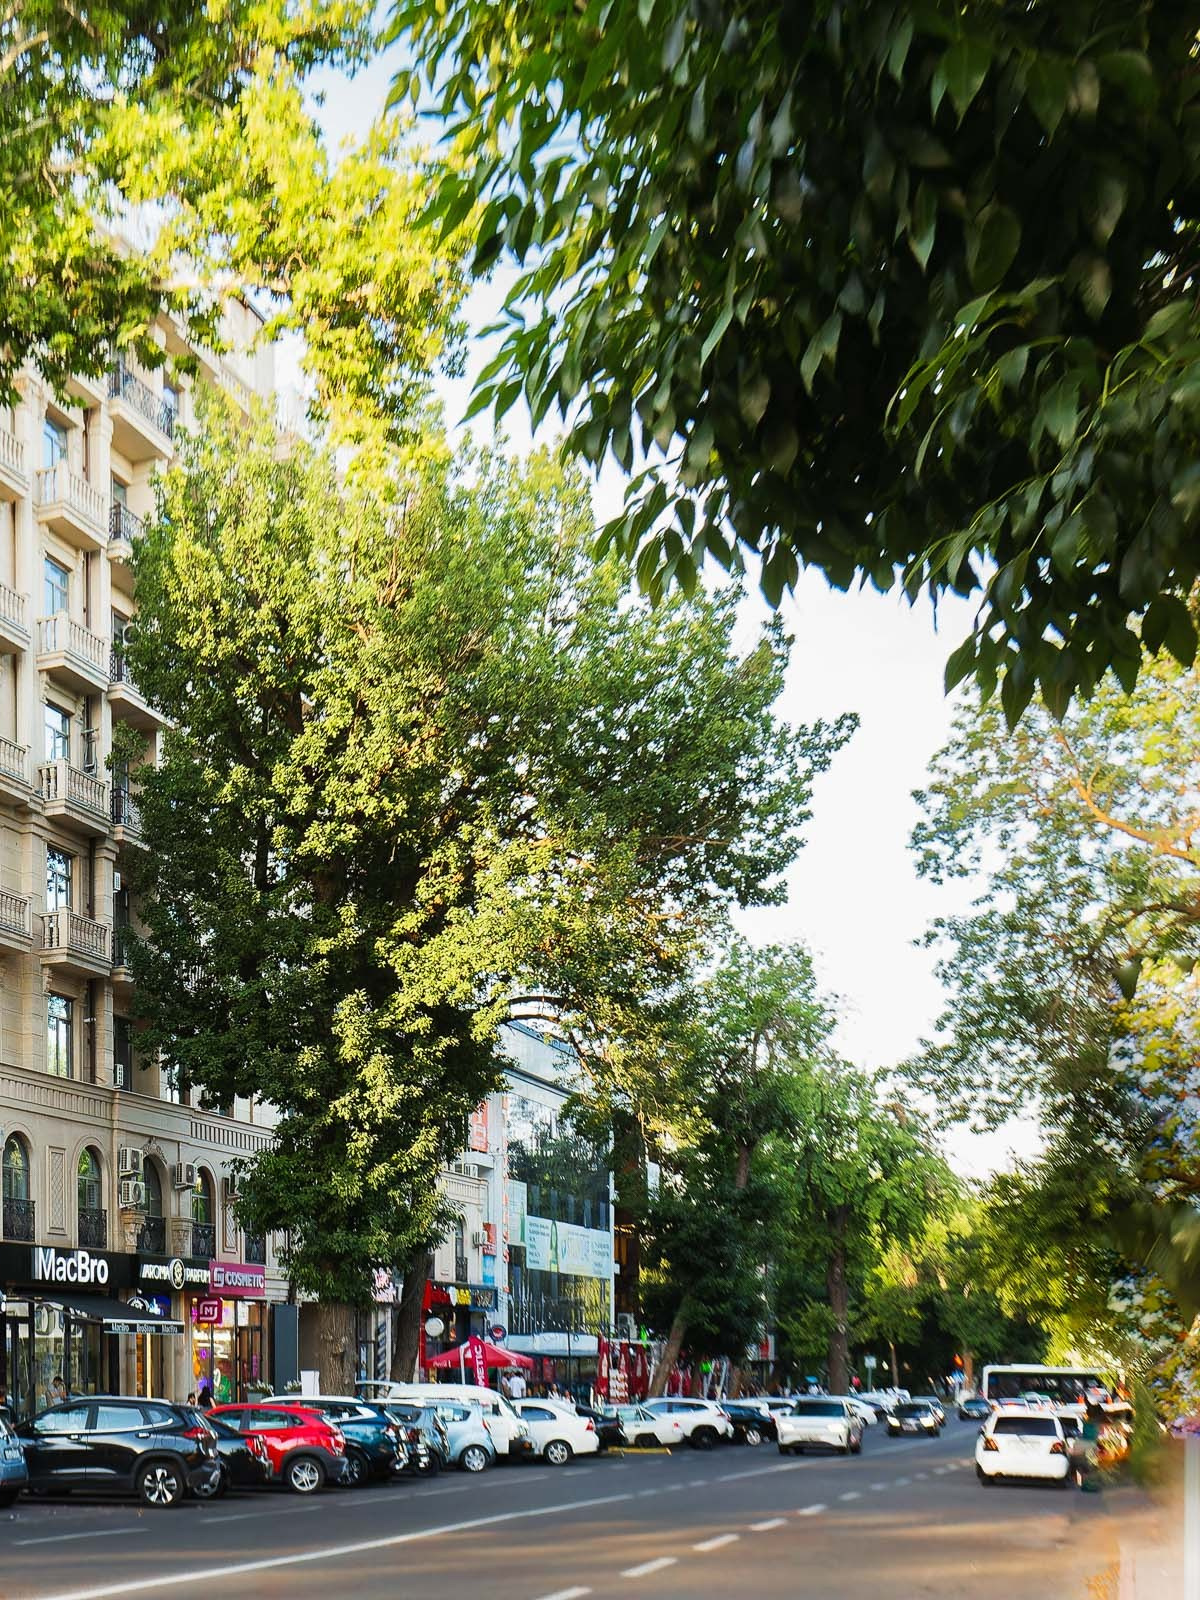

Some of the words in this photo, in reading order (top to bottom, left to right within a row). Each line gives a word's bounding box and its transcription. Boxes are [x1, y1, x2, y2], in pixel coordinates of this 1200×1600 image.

[38, 1247, 109, 1284] MacBro
[141, 1263, 171, 1281] AROMA
[185, 1267, 211, 1284] PARFUM
[225, 1270, 264, 1289] COSMETIC
[111, 1322, 130, 1333] MacBro
